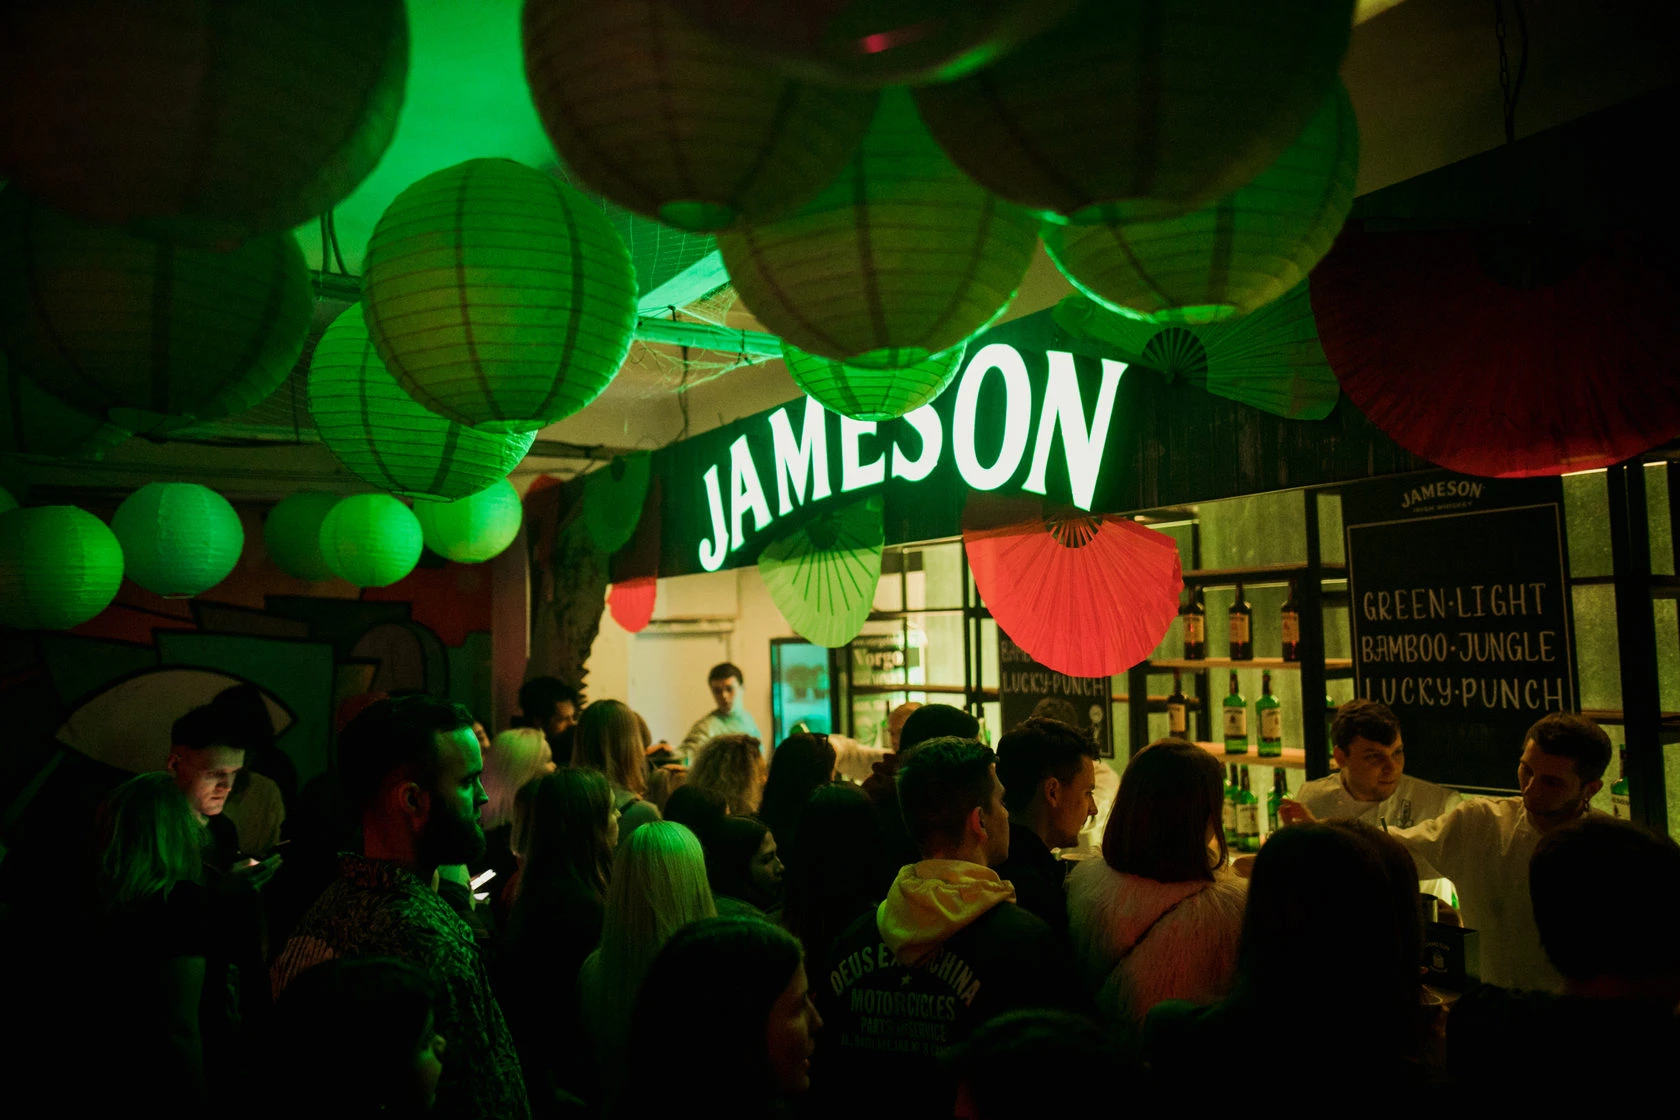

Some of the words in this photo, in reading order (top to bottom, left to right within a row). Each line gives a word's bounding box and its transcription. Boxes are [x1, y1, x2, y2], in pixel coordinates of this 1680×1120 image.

[699, 343, 1129, 572] JAMESON
[1401, 480, 1484, 509] JAMESON
[830, 945, 875, 997] DEUS
[850, 987, 957, 1022] MOTORCYCLES
